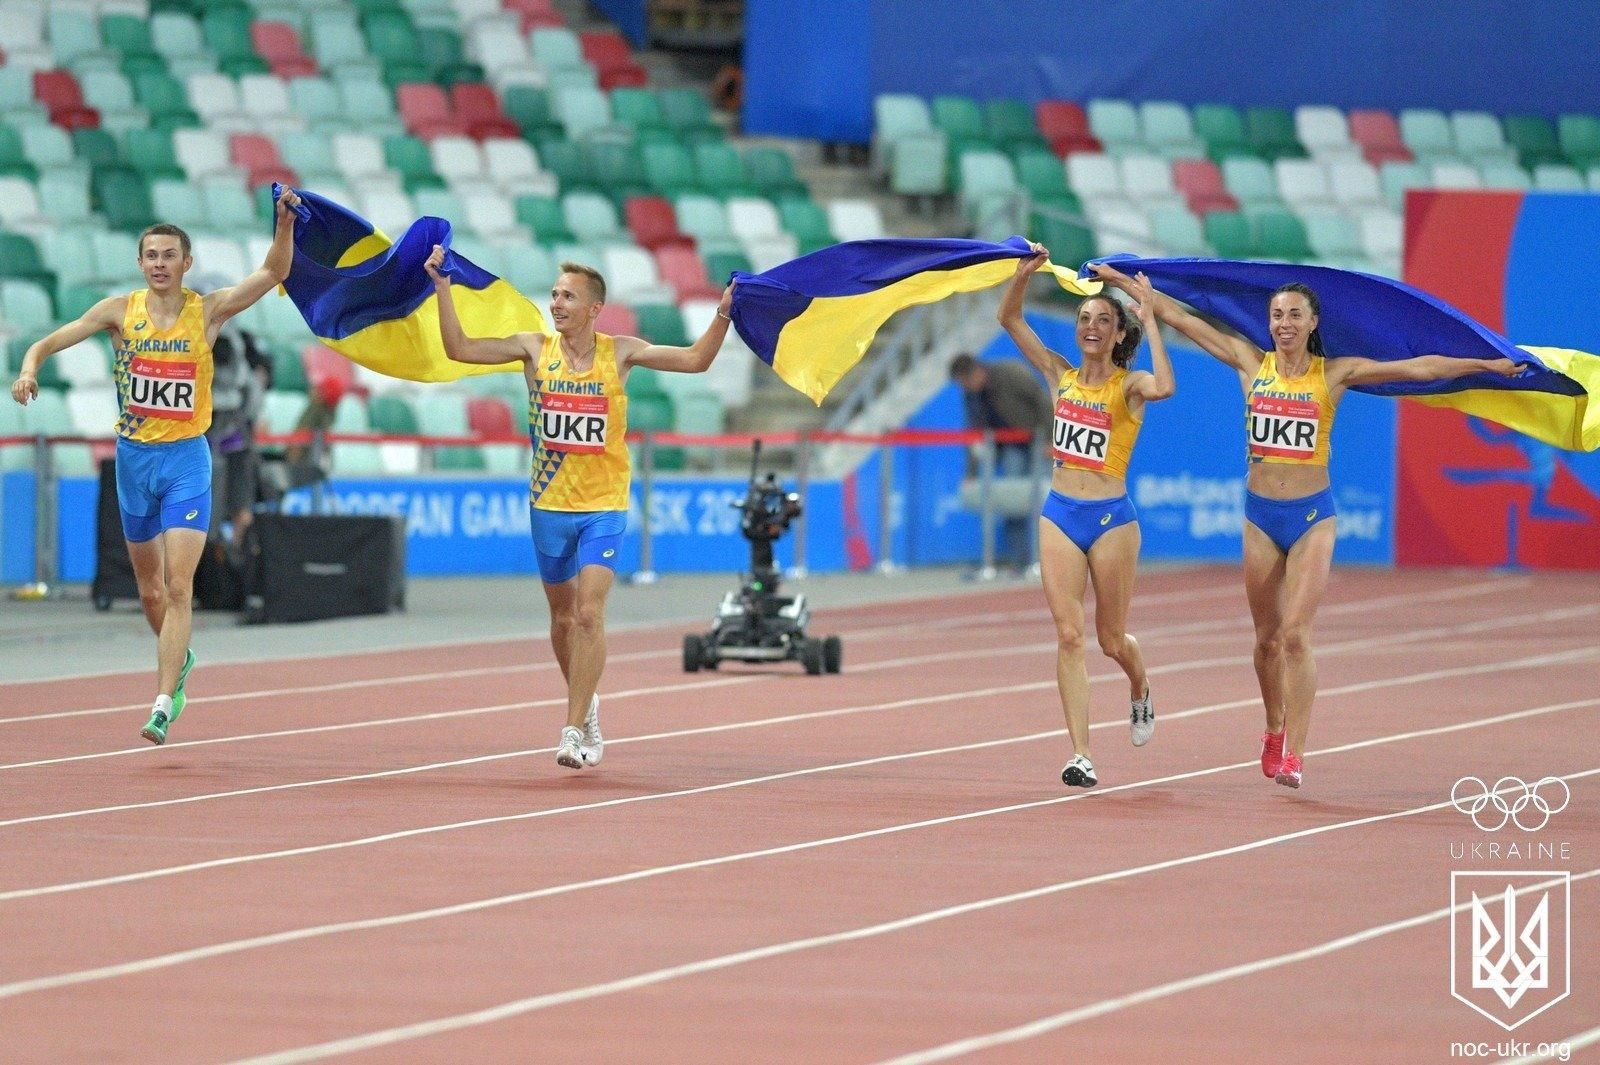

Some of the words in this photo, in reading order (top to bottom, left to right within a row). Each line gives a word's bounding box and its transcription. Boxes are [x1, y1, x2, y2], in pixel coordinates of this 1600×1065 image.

[135, 339, 191, 353] UKRAINE
[131, 377, 192, 408] UKR
[549, 379, 604, 395] UKRAINE
[543, 412, 605, 442] UKR
[1053, 419, 1107, 458] UKR
[1252, 416, 1316, 448] UKR
